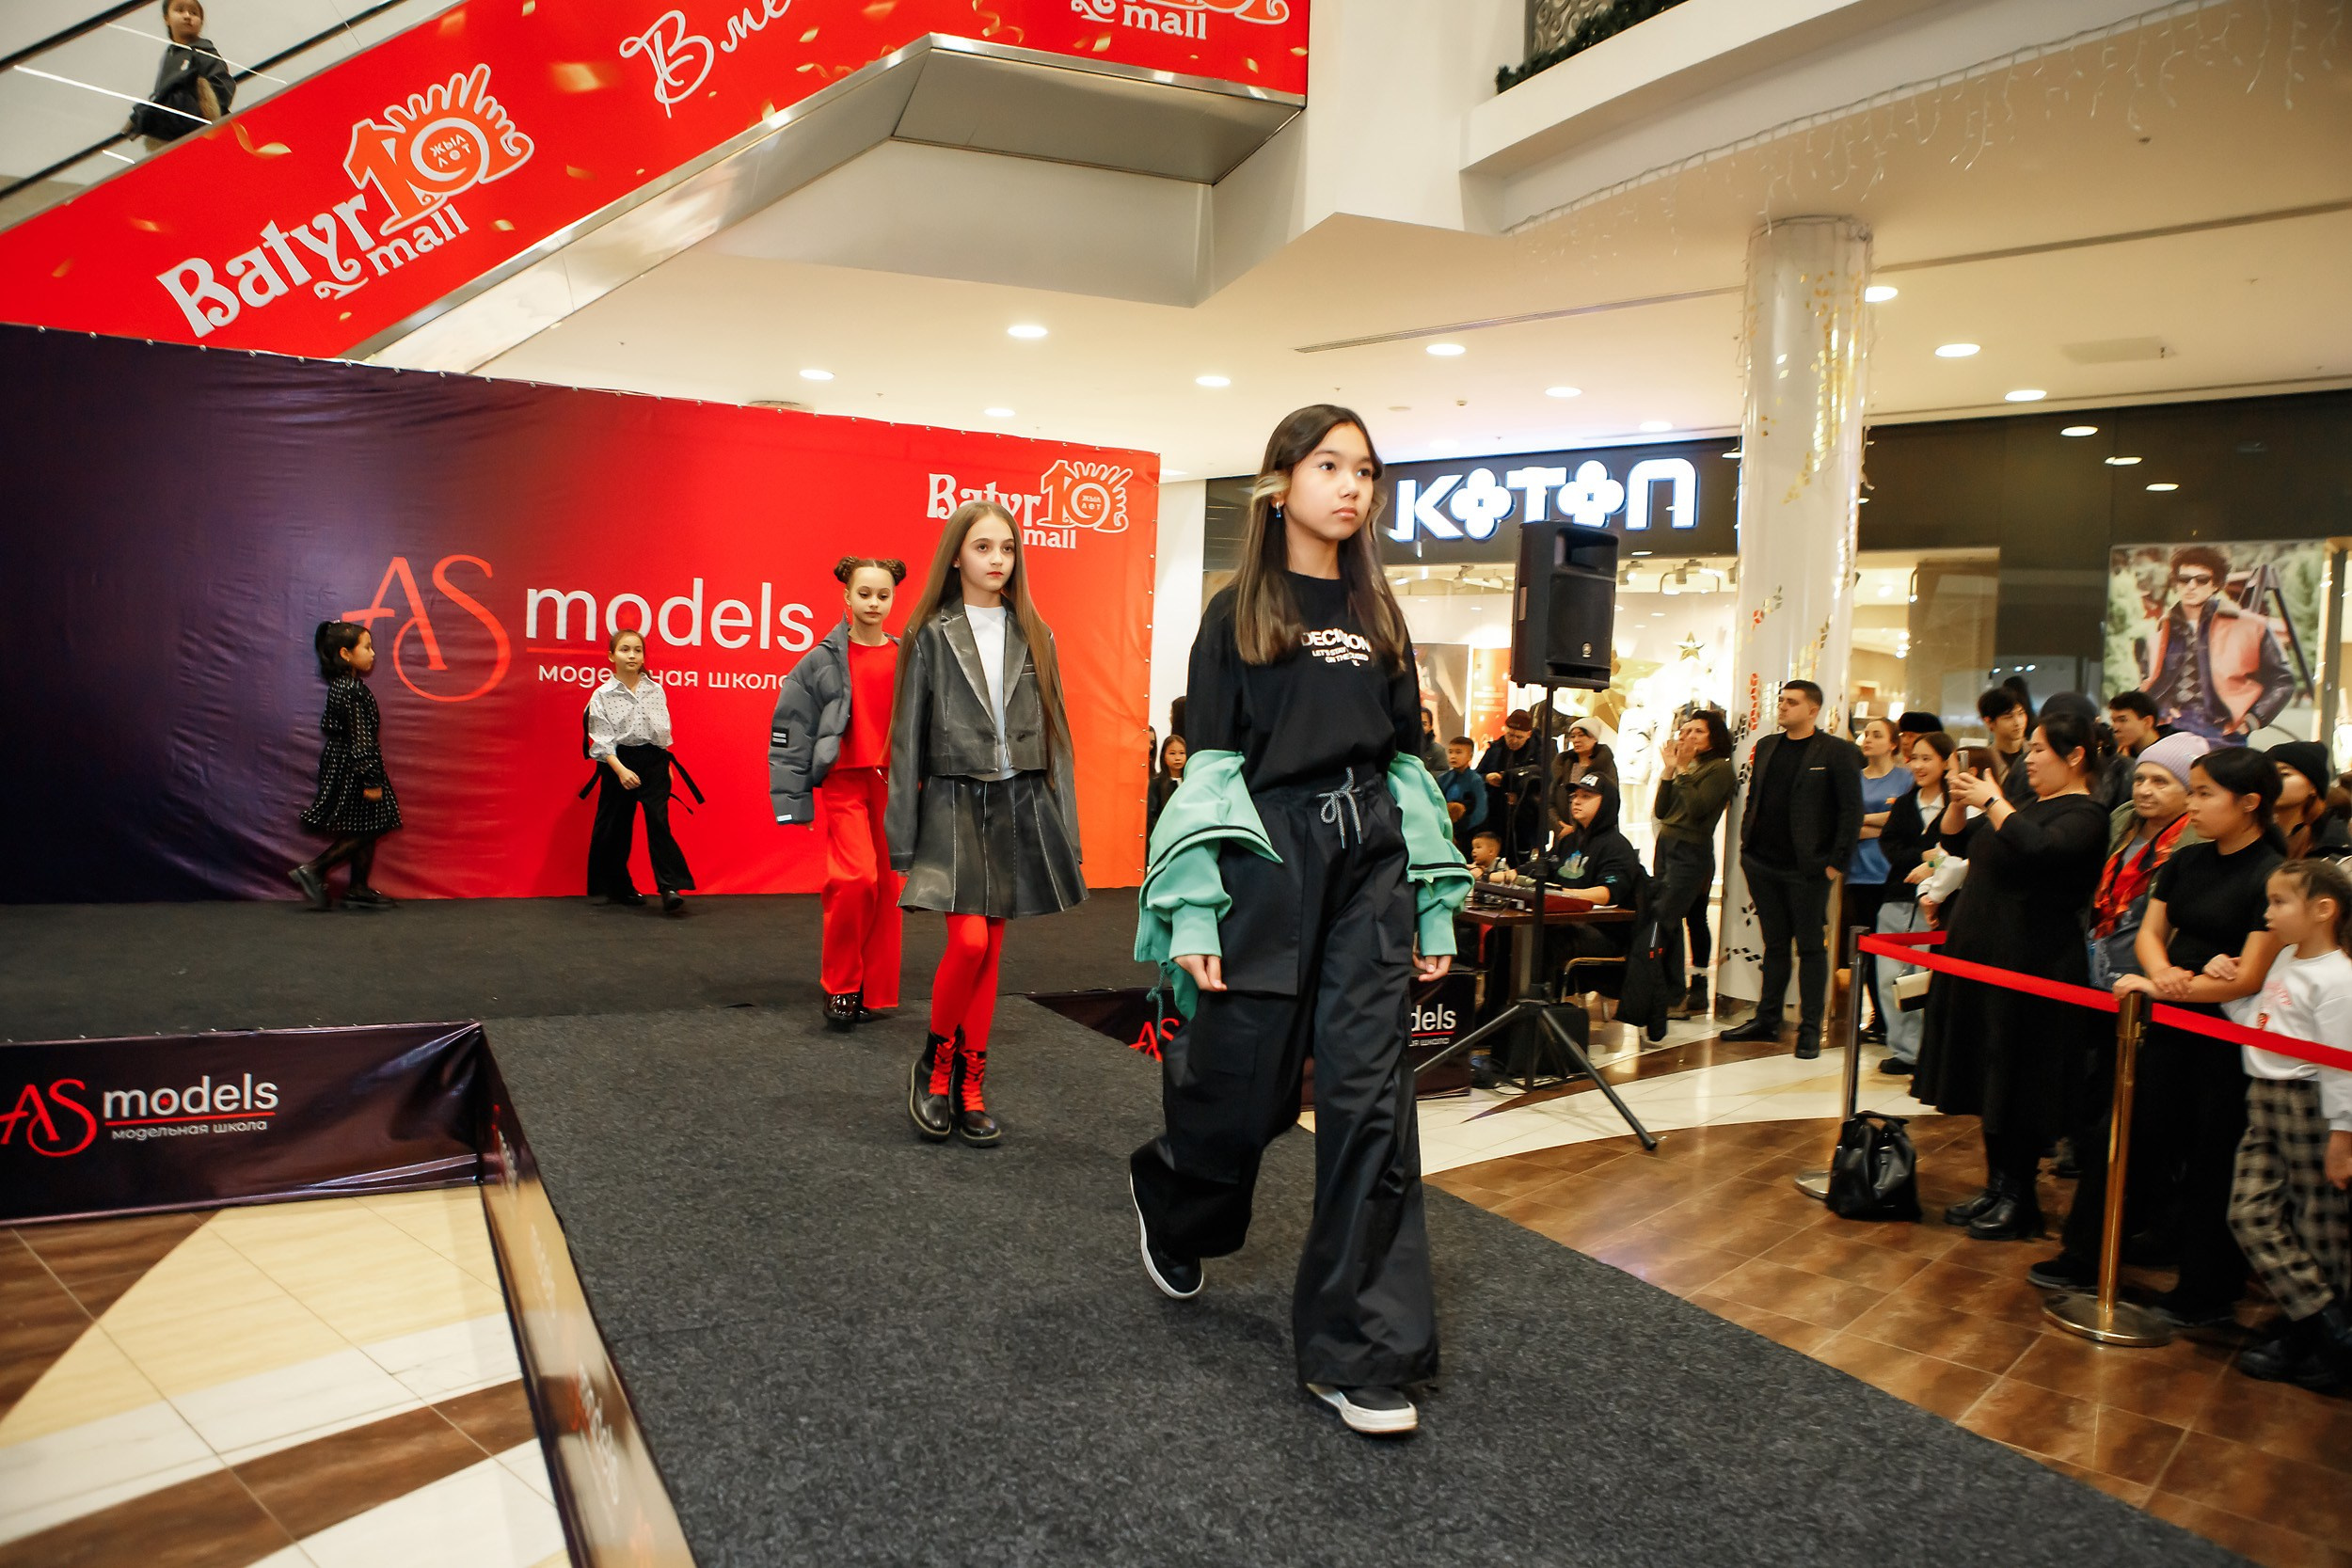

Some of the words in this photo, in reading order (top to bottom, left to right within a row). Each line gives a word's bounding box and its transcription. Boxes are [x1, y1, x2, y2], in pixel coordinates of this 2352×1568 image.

[1122, 4, 1207, 40] mall
[365, 203, 469, 277] mall
[156, 194, 375, 339] Batyr
[1024, 529, 1076, 548] mall
[342, 554, 511, 702] AS
[526, 578, 815, 651] models
[538, 664, 699, 689] моденая
[1411, 1004, 1456, 1032] dels
[0, 1078, 98, 1157] AS
[103, 1073, 278, 1118] models
[111, 1125, 209, 1141] модельная
[213, 1120, 267, 1133] школа
